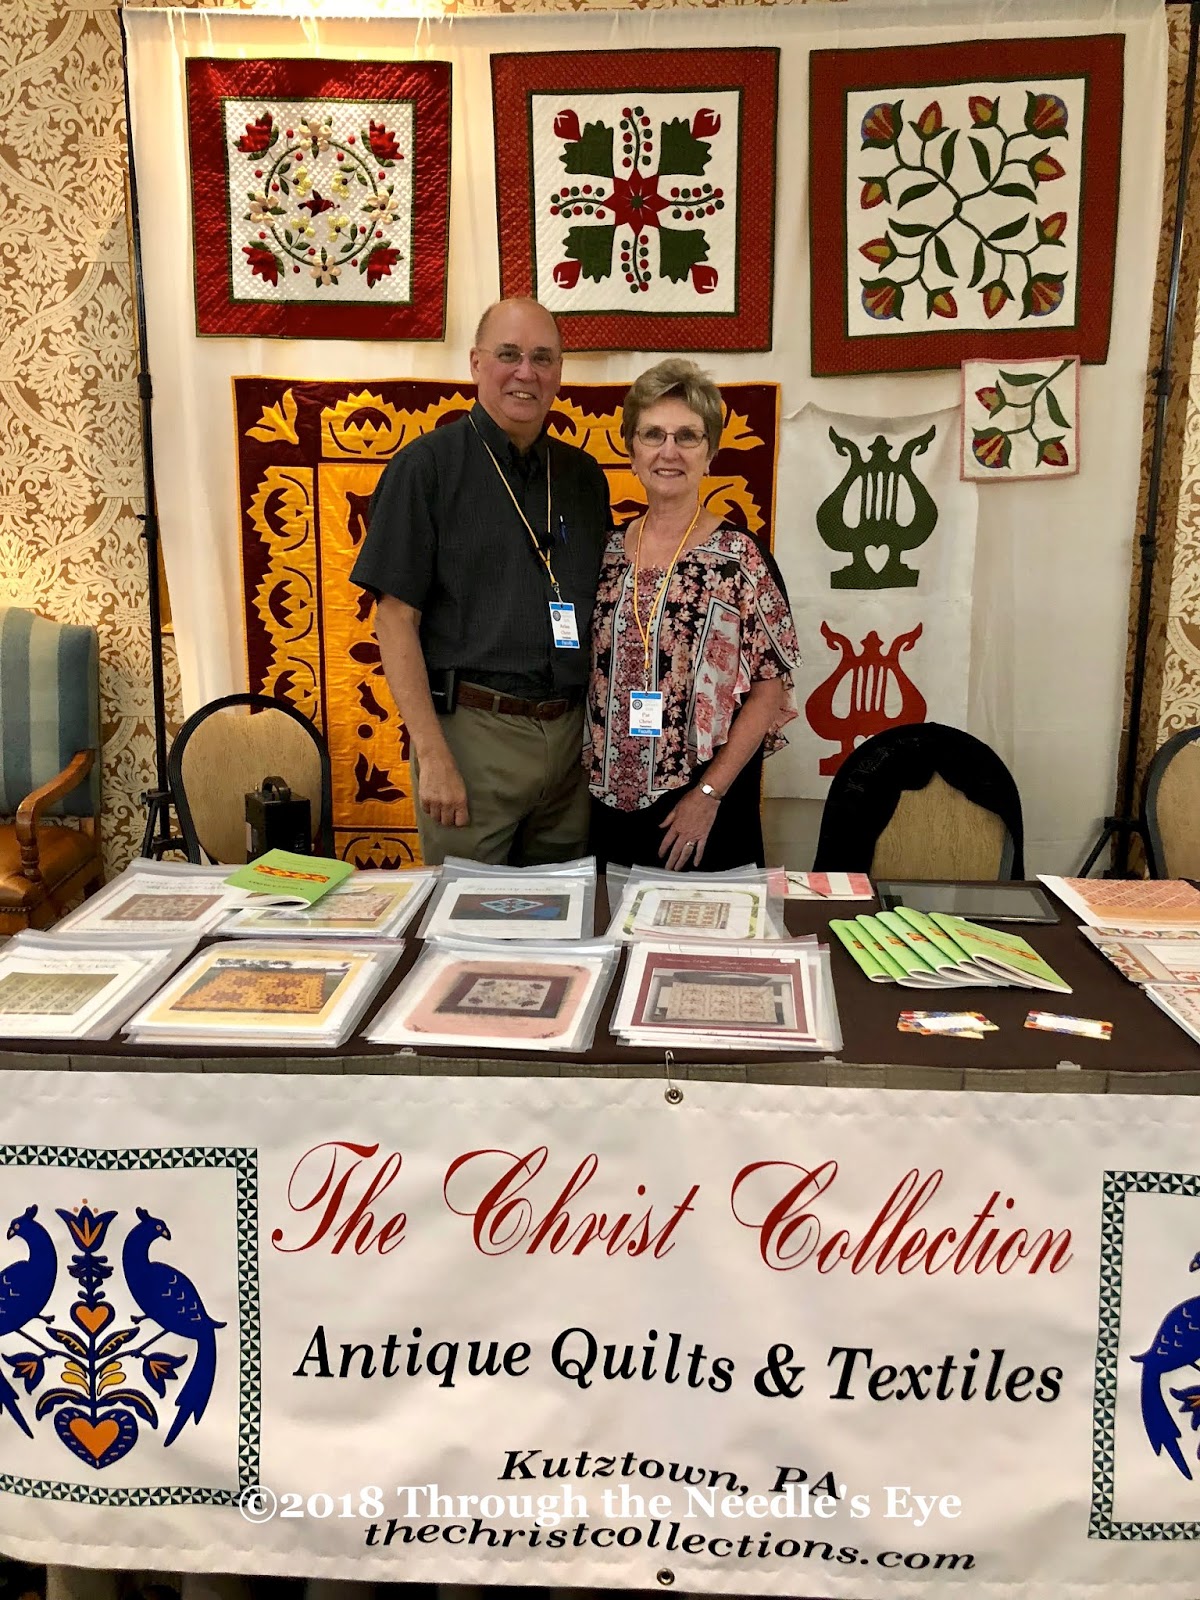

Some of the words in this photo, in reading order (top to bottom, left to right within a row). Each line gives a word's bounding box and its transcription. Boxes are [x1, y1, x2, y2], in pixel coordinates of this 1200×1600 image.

[272, 1141, 407, 1255] The
[443, 1145, 701, 1258] Christ
[730, 1159, 1074, 1277] Collection
[293, 1325, 531, 1388] Antique
[551, 1327, 735, 1392] Quilts
[753, 1343, 806, 1399] &
[828, 1346, 1064, 1403] Textiles
[497, 1449, 749, 1497] Kutztown,
[768, 1465, 842, 1500] PA
[364, 1518, 977, 1570] thechristcollections.com
